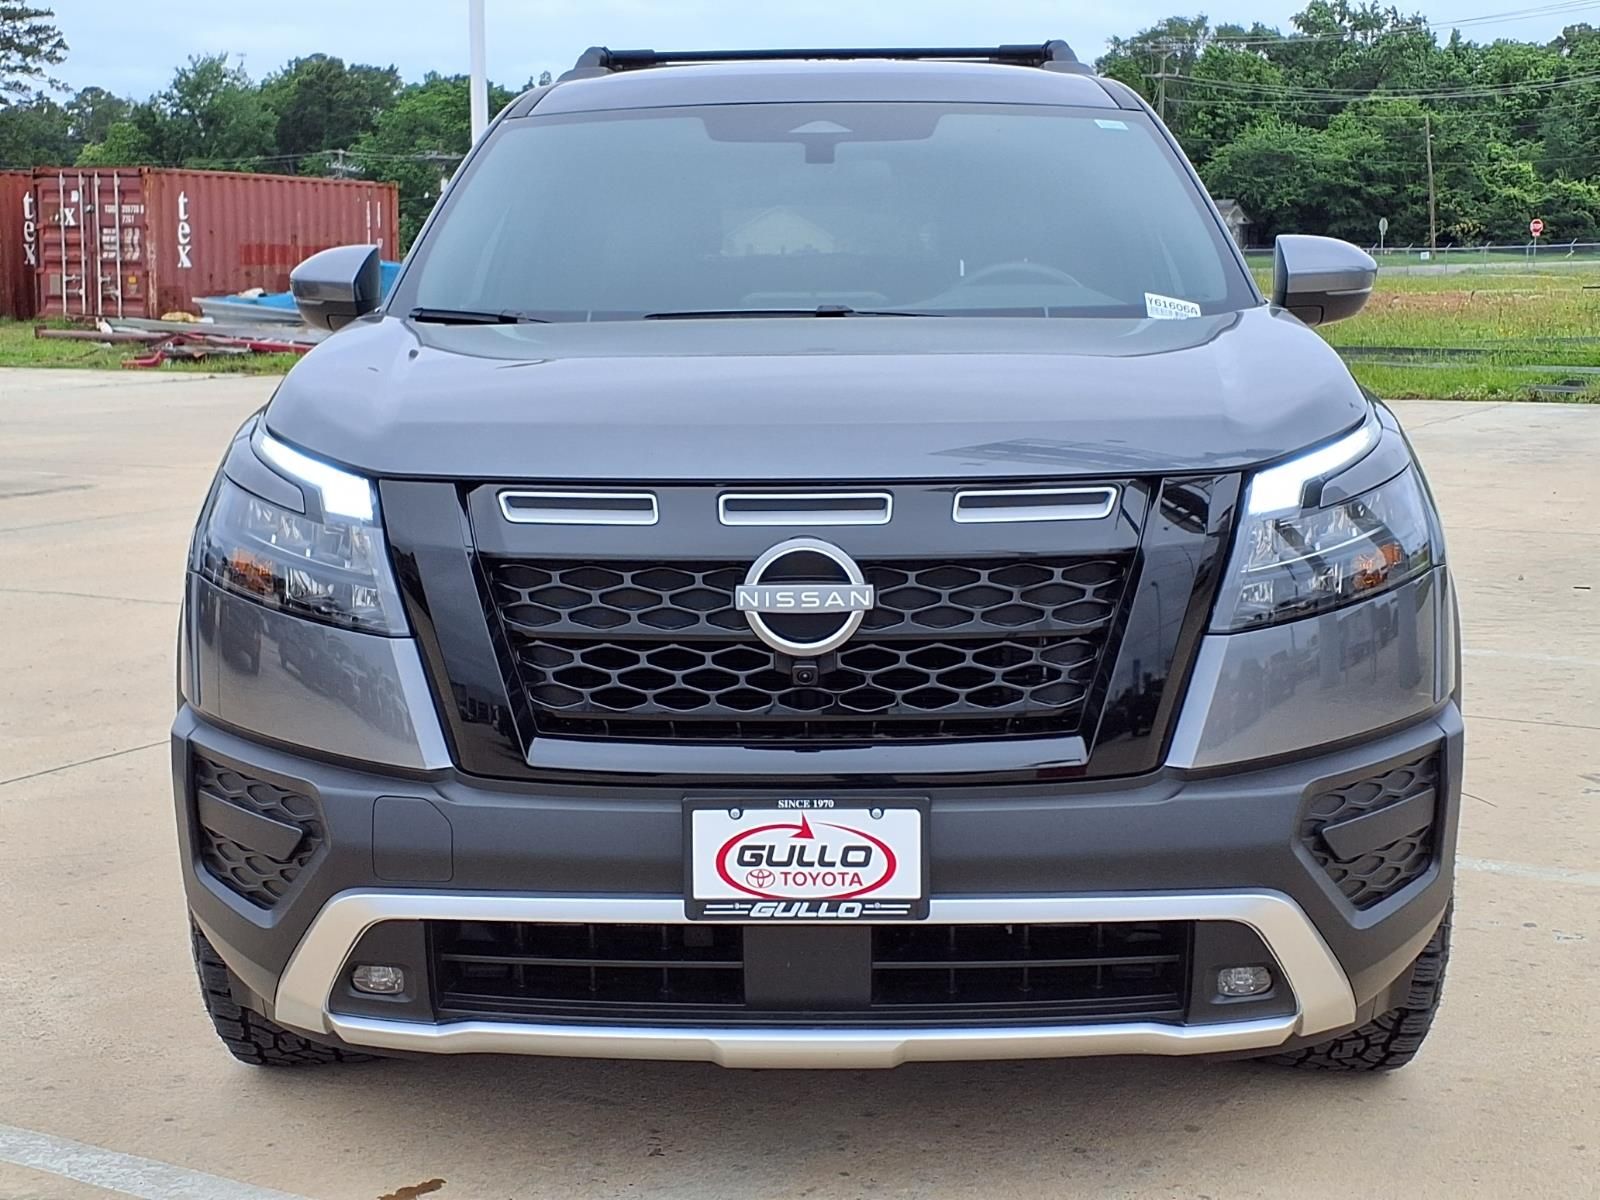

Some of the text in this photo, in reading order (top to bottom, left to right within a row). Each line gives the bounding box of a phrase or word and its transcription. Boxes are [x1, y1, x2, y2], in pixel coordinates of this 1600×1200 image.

[23, 191, 36, 266] tex
[177, 191, 192, 268] tex
[1147, 296, 1198, 316] Y61606A
[739, 590, 870, 608] NISSAN
[777, 799, 834, 809] SINCE 1970
[736, 844, 873, 868] GULLO
[780, 871, 863, 887] TOYOTA
[749, 902, 863, 918] GULLO
